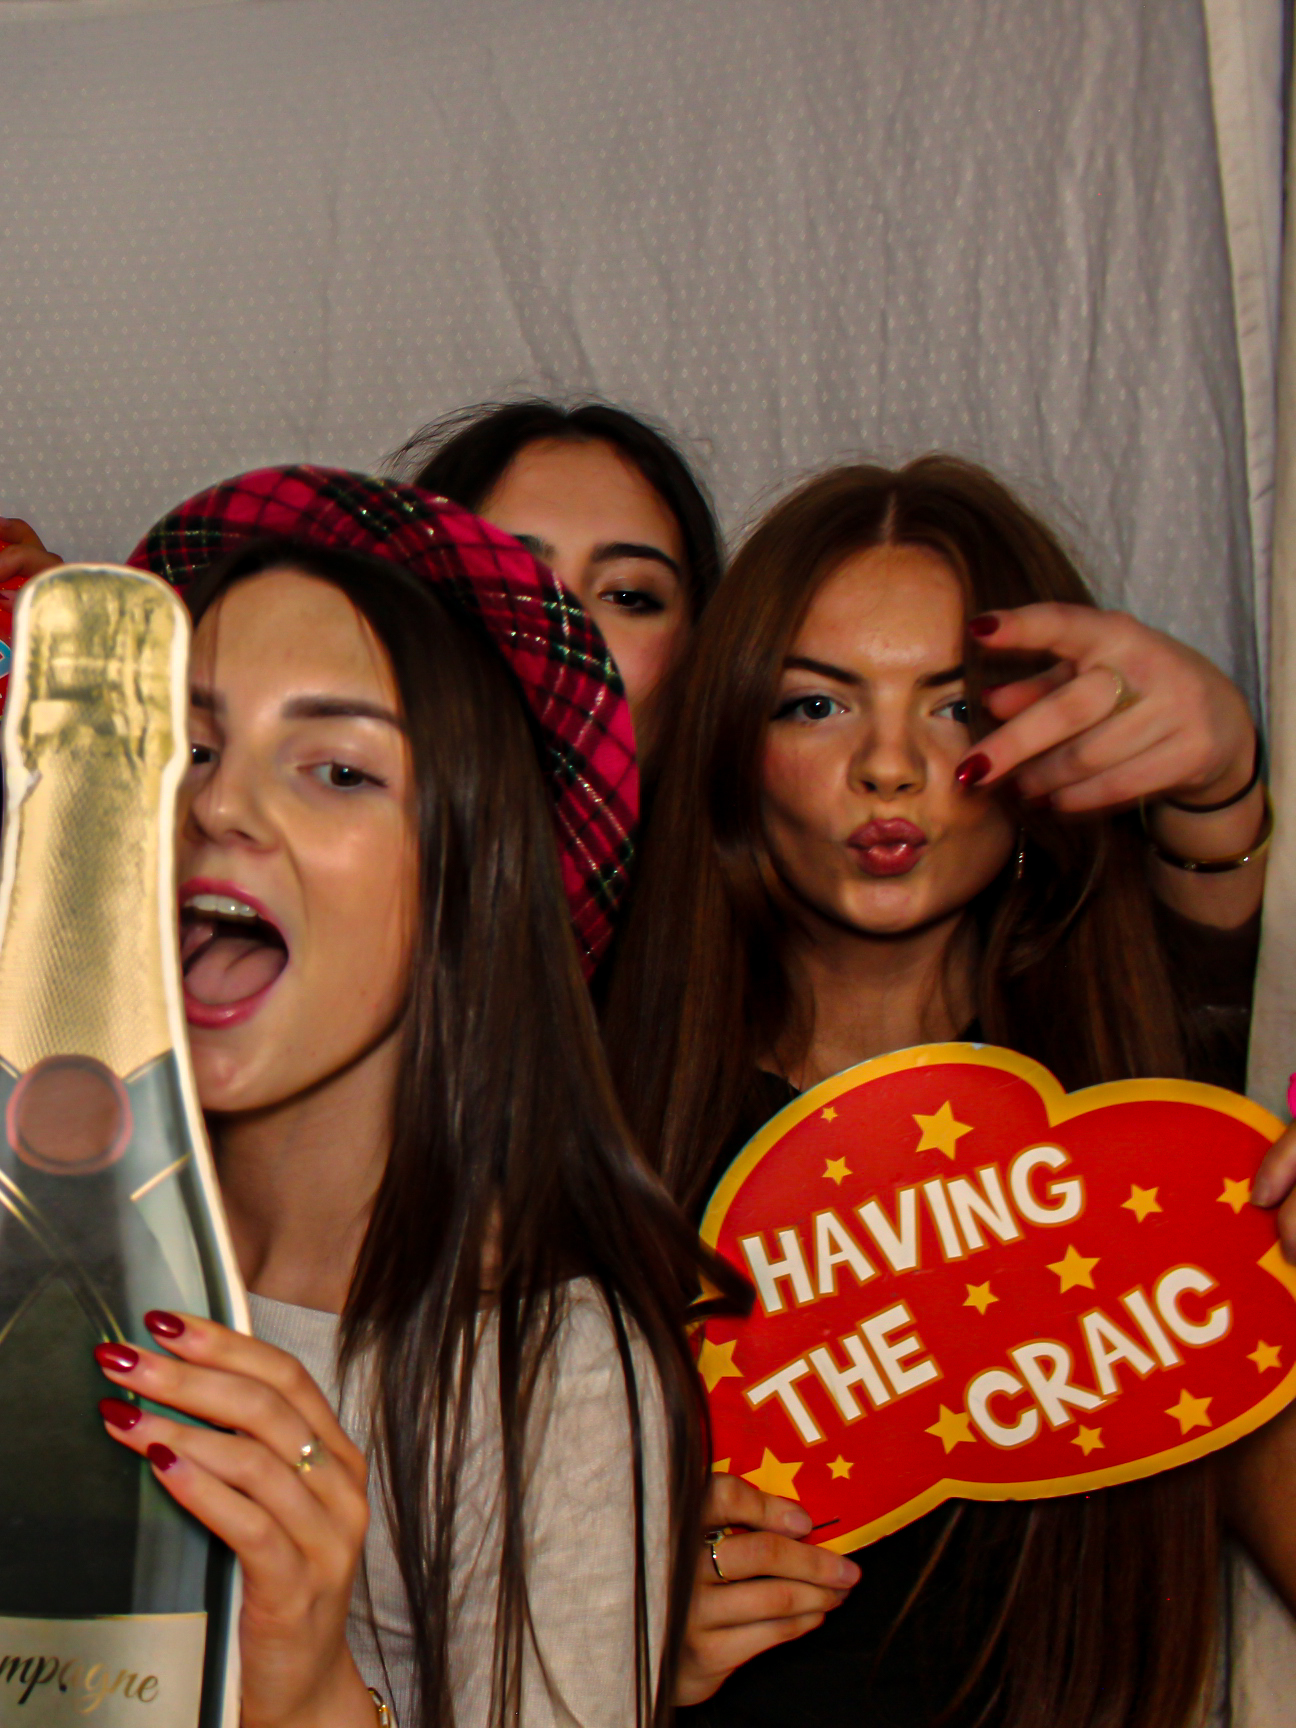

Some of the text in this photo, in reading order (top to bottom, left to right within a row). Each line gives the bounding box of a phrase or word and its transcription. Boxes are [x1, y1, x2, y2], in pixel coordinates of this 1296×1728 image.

[741, 1145, 1084, 1315] HAVING
[745, 1265, 1231, 1448] THE CRAIC
